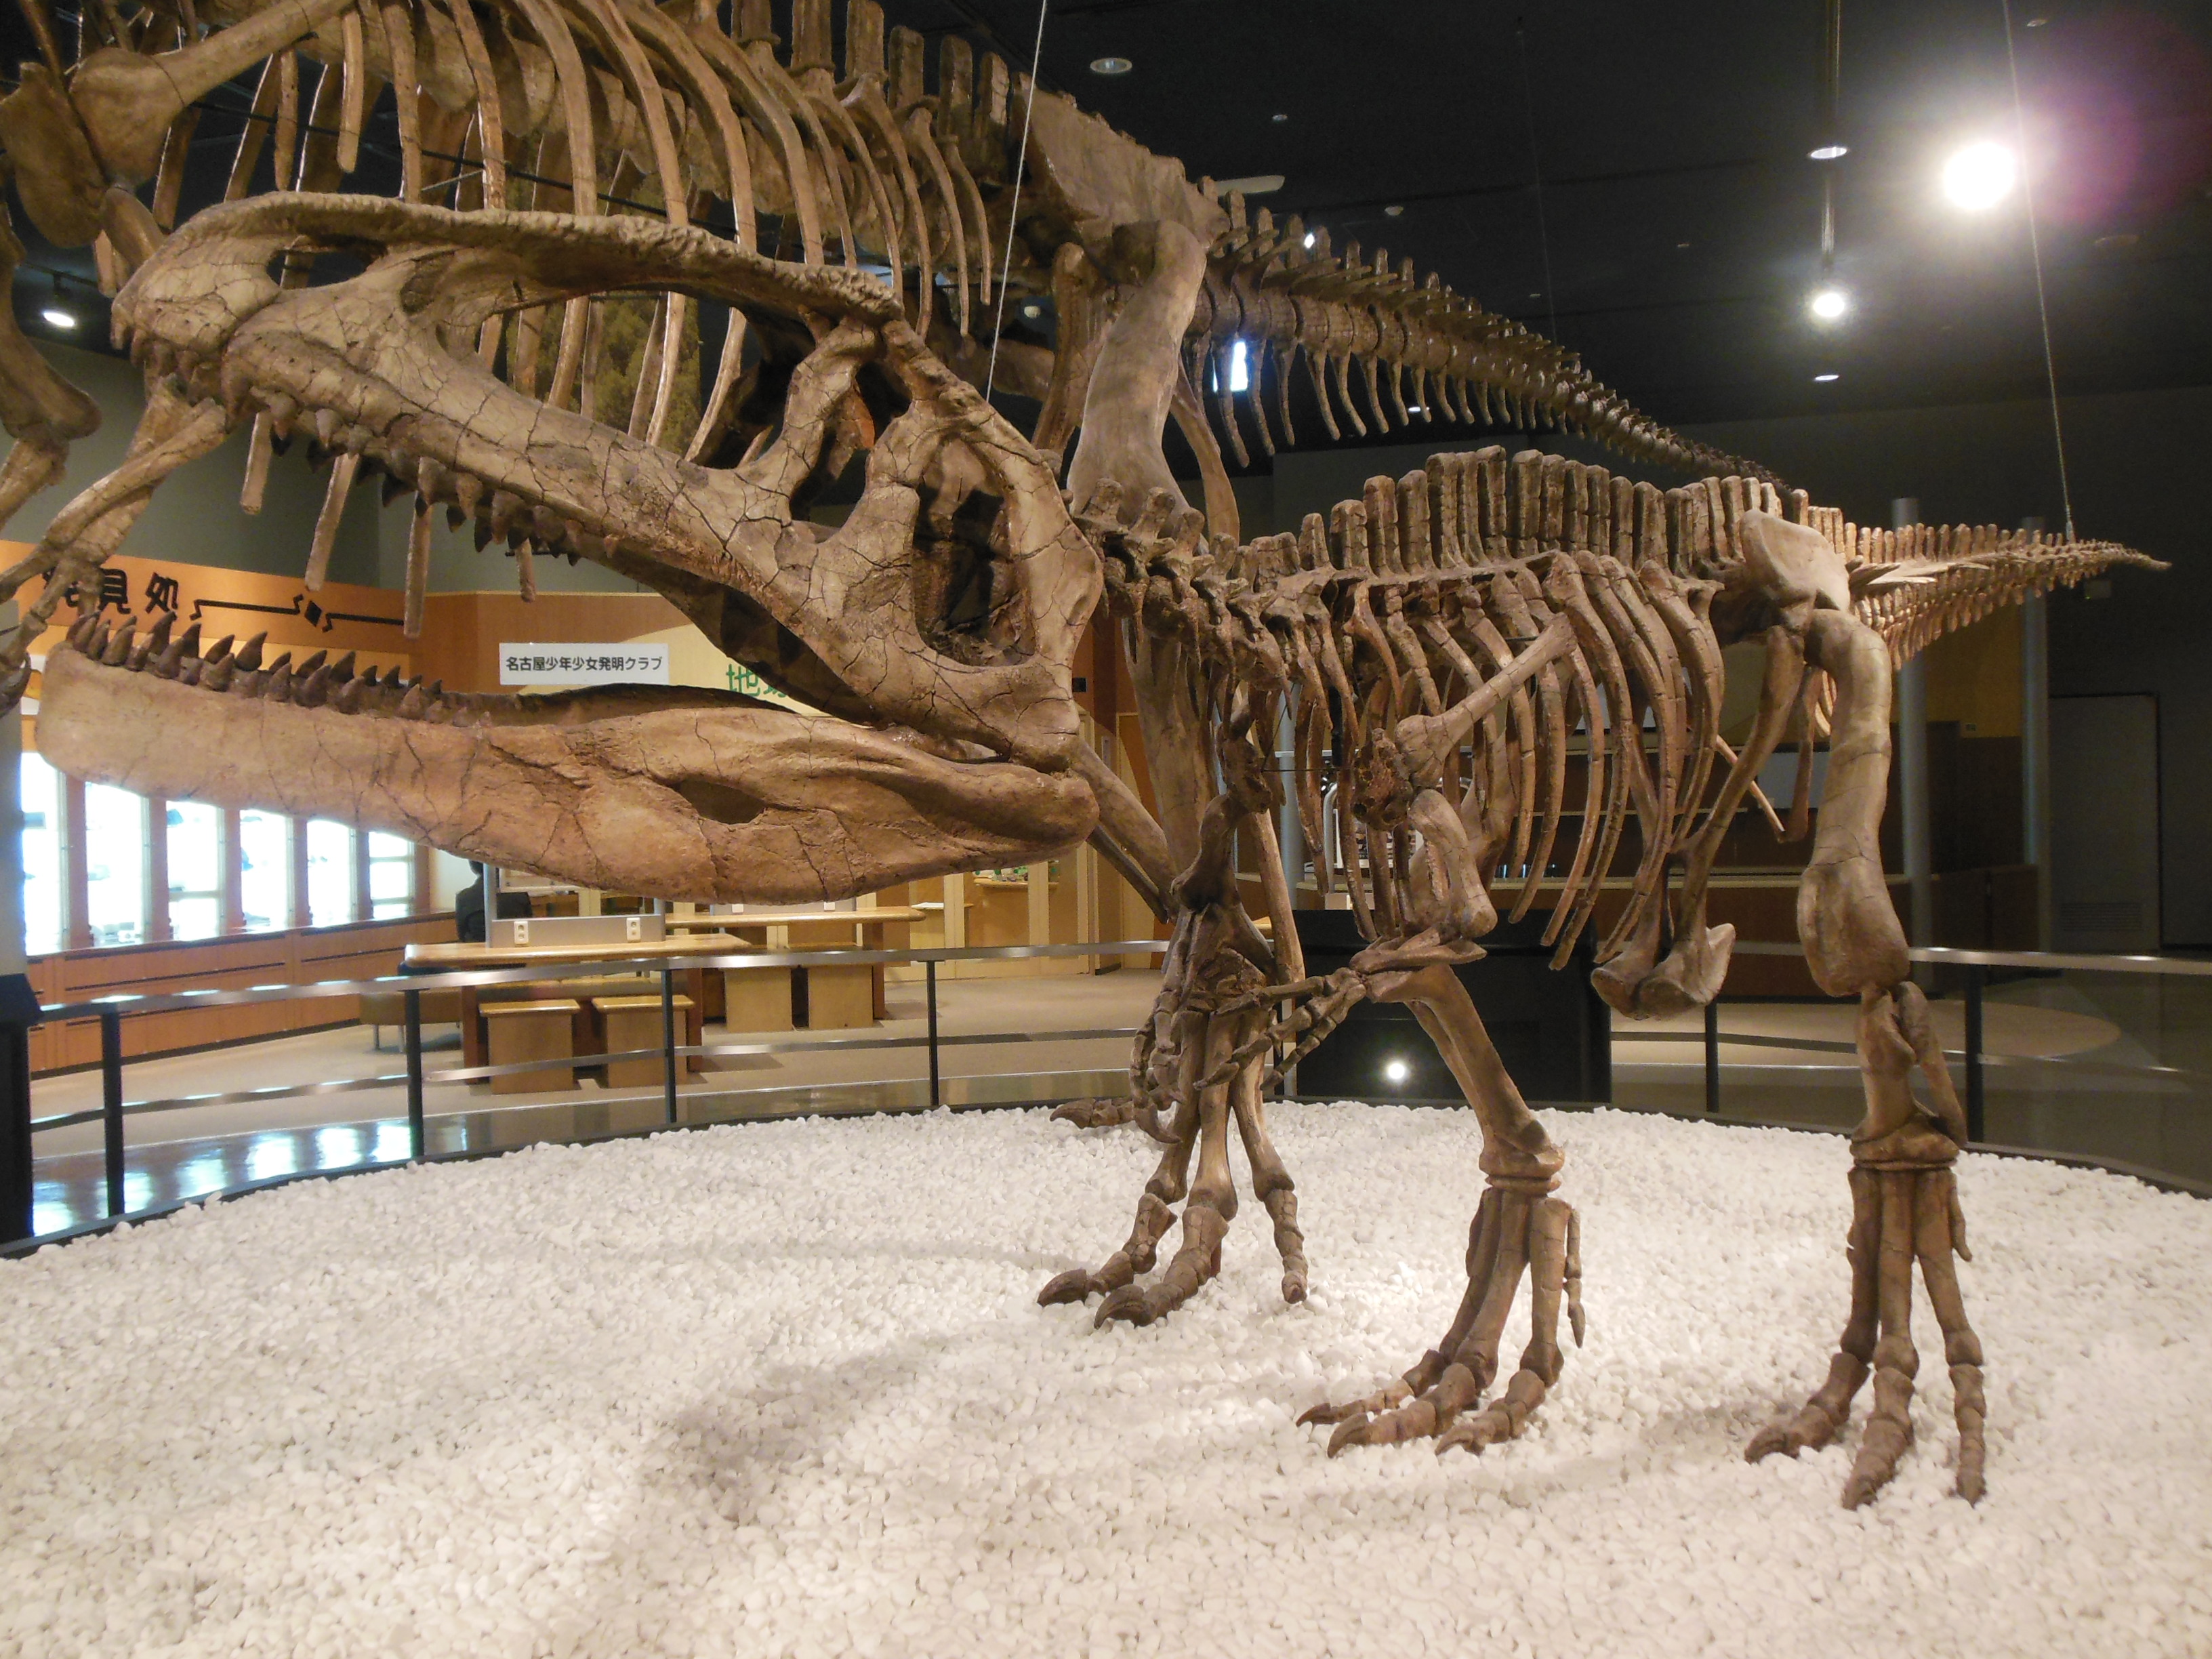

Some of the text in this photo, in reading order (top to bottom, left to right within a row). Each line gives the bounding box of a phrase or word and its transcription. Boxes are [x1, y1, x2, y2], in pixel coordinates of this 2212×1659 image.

[42, 567, 178, 614] 見処
[506, 657, 662, 671] 名古屋少年少女発明クラブ
[726, 663, 786, 697] 地
